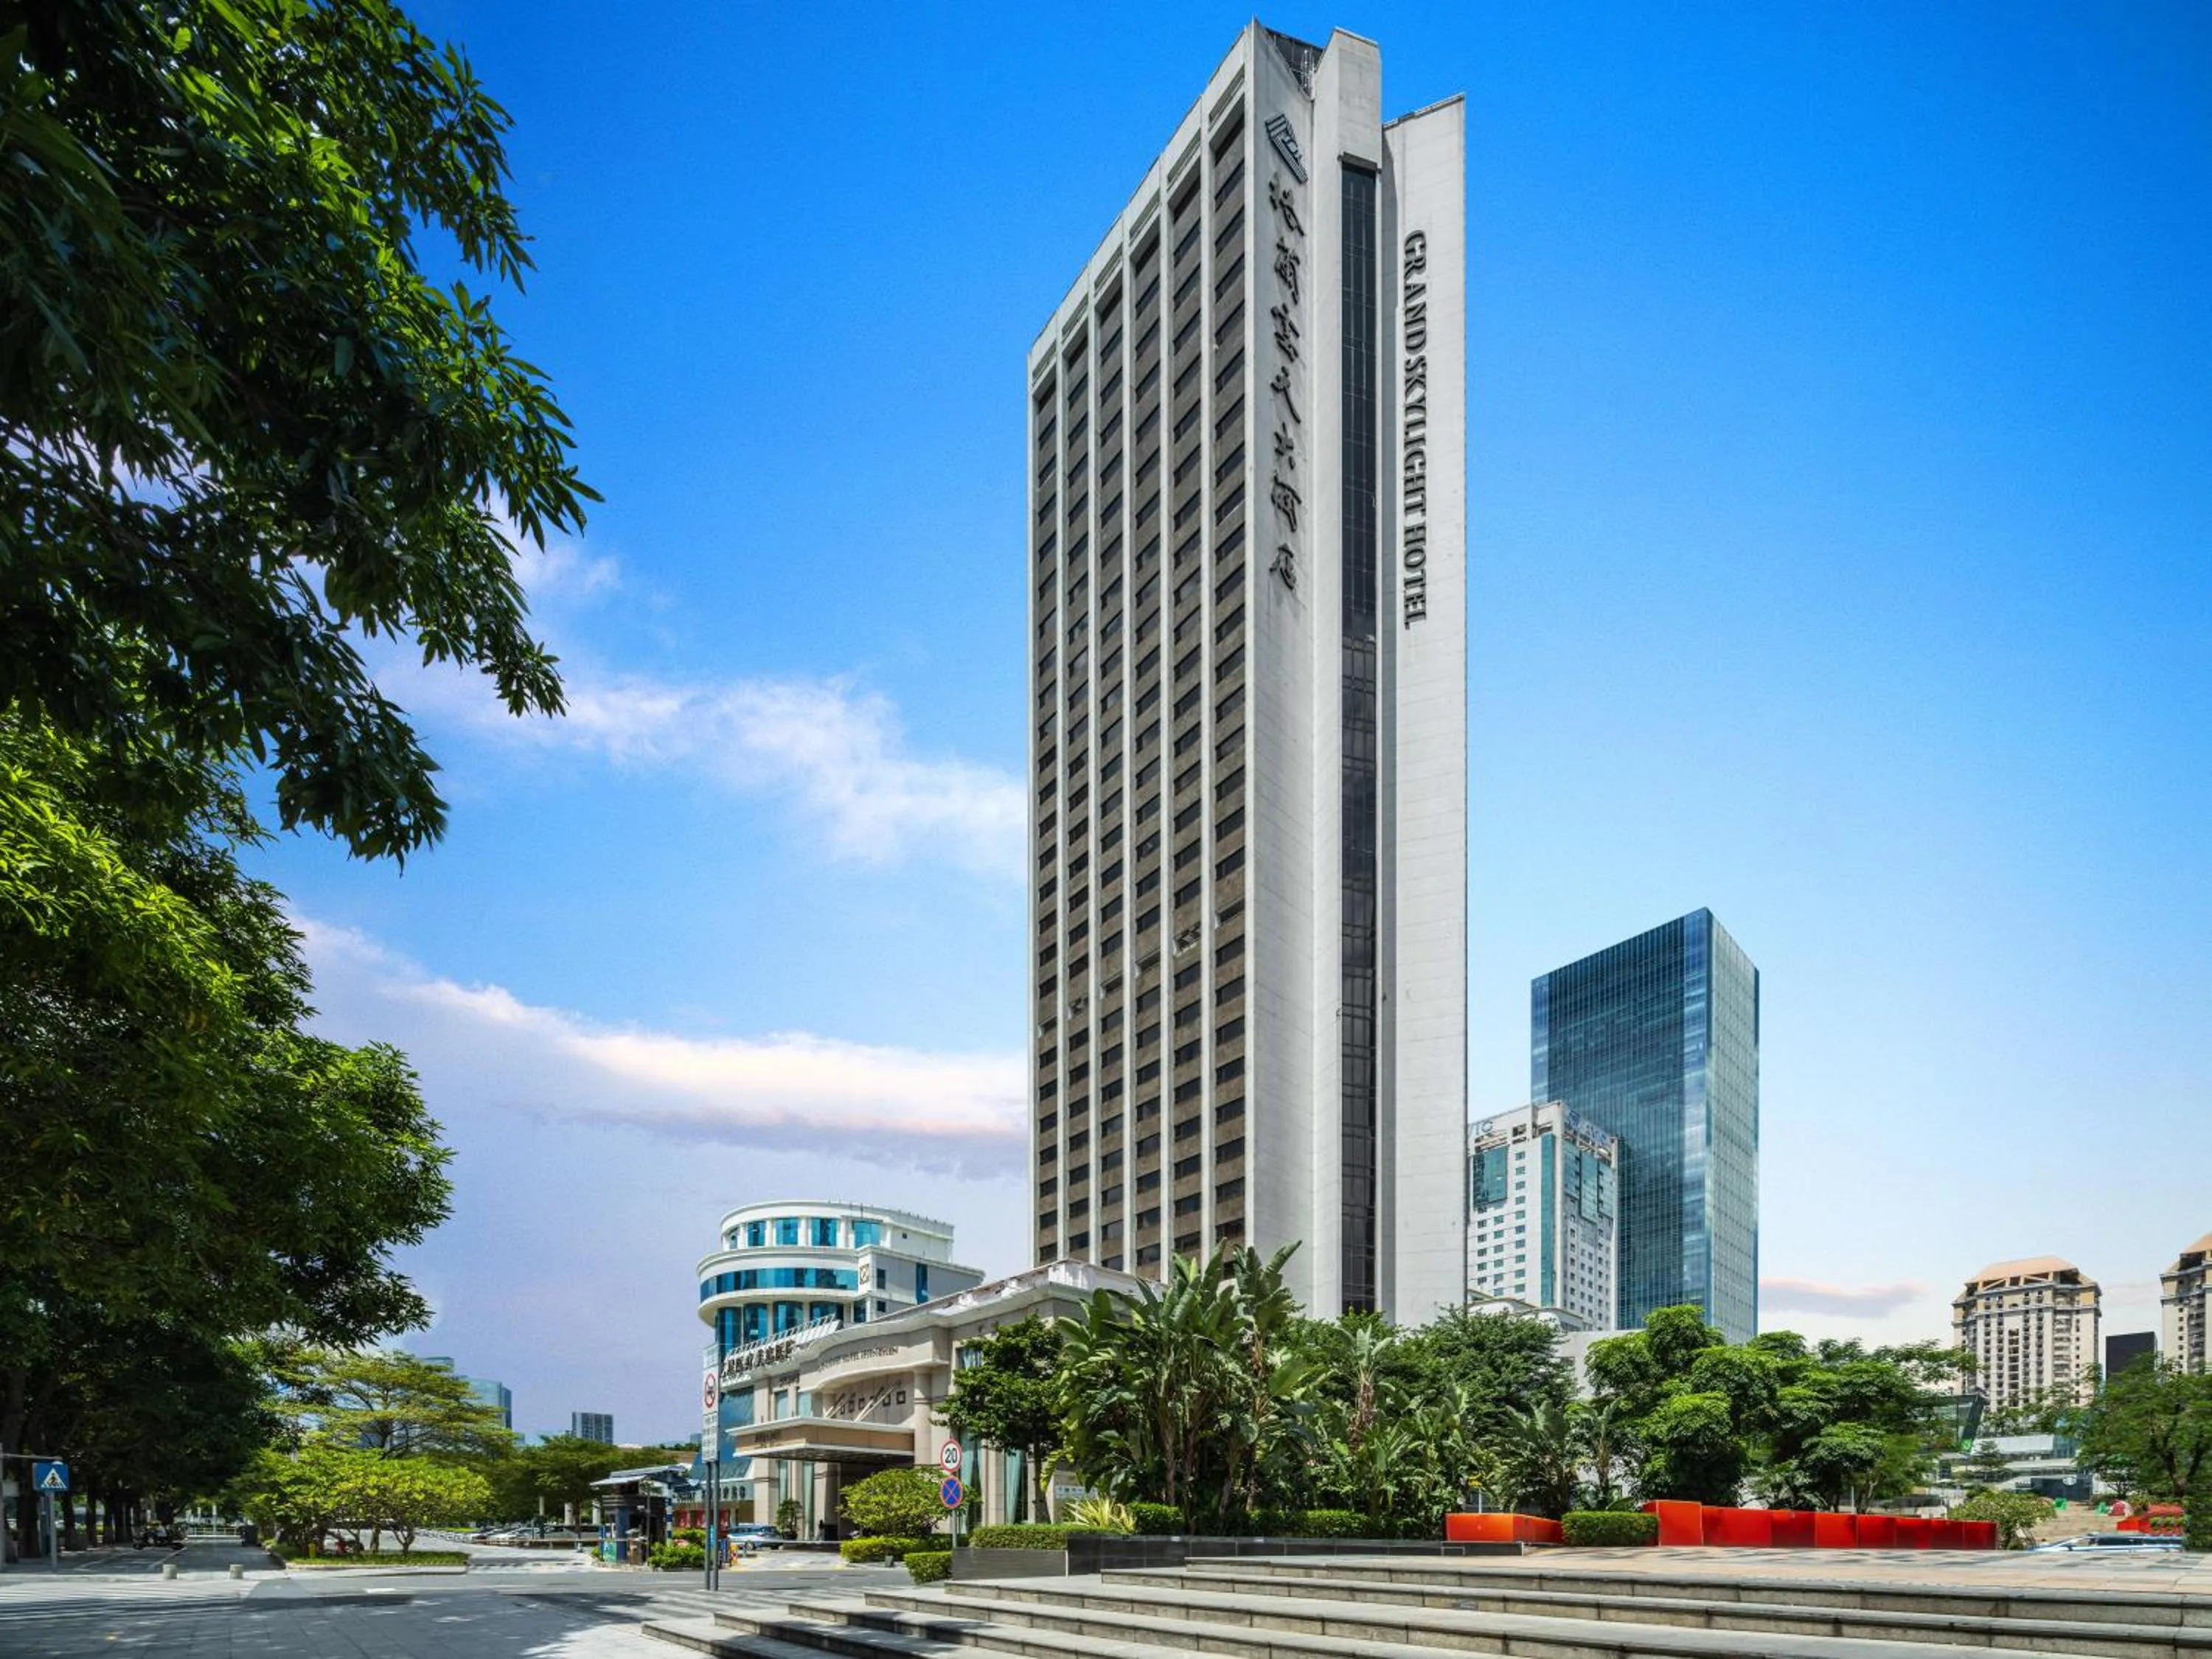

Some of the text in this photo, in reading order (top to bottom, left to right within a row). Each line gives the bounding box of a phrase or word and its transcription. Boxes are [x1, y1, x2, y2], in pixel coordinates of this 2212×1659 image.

[1404, 229, 1427, 630] GRAND SKYLIGHT HOTEL
[945, 1447, 958, 1464] 20
